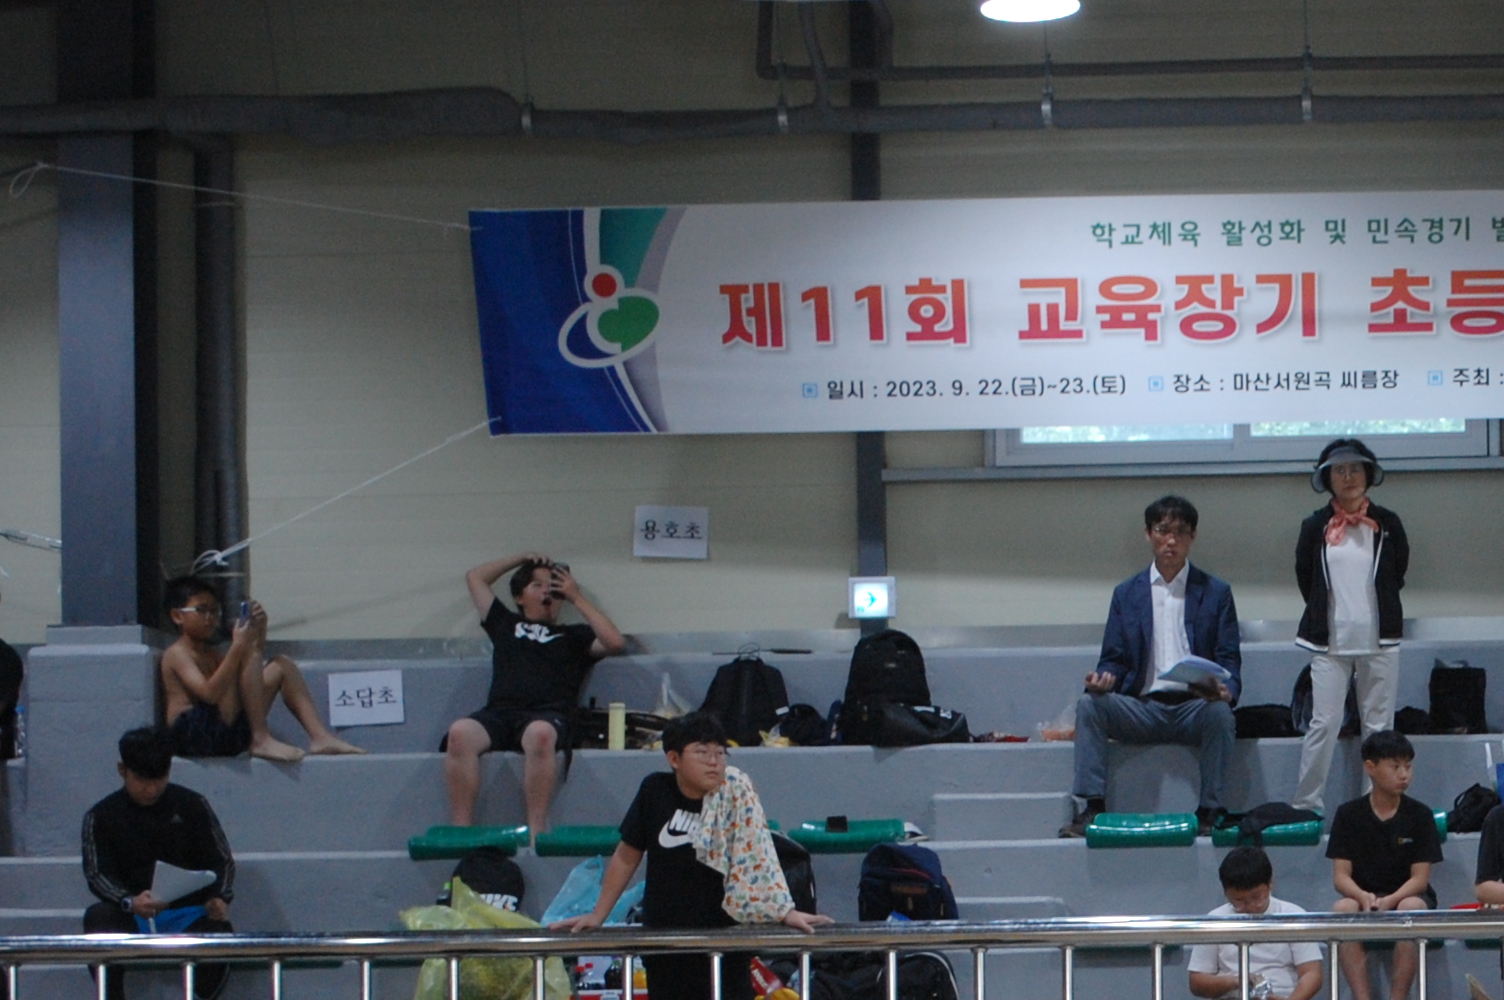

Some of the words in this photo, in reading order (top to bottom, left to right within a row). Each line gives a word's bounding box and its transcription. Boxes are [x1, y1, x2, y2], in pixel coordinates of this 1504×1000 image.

[1090, 220, 1201, 249] 학교체육
[1221, 218, 1306, 247] 활성화
[1324, 218, 1346, 245] 및
[1367, 216, 1471, 245] 민속경기
[720, 278, 967, 347] 제11회
[1020, 273, 1316, 341] 교육장기
[1172, 373, 1211, 394] 장소
[1233, 370, 1332, 392] 마산서원곡
[1340, 369, 1400, 390] 씨름장
[1452, 367, 1490, 387] 주최
[826, 380, 864, 401] 일시
[640, 519, 702, 541] 용호초
[335, 686, 397, 709] 소답초
[668, 808, 702, 833] NIK
